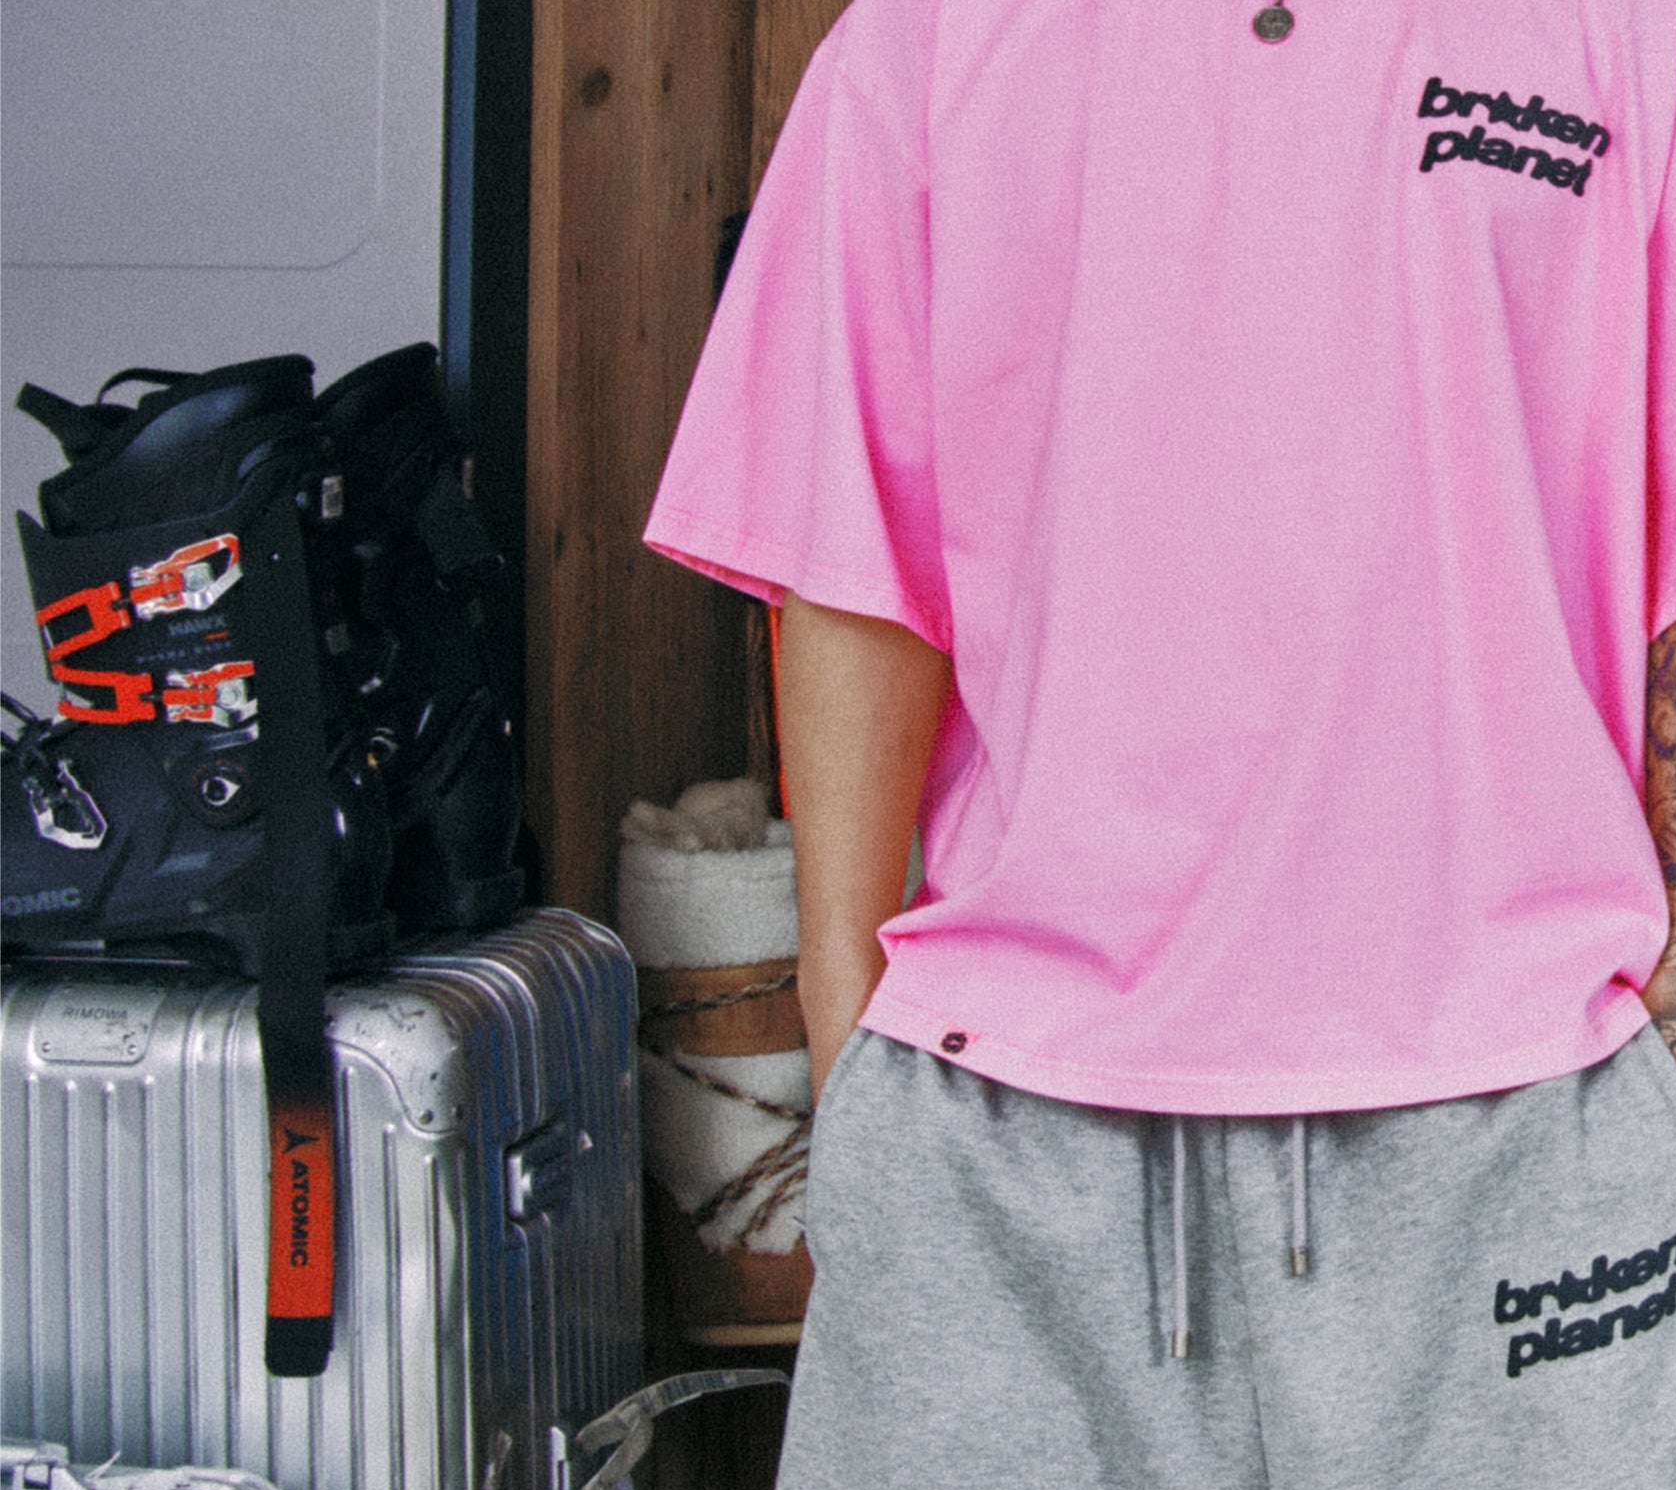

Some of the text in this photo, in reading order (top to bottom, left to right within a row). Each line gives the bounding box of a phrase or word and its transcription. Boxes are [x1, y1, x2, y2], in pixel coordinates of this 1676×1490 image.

[1419, 125, 1593, 197] planet
[62, 1006, 130, 1021] RIMOWA
[290, 1158, 310, 1268] ATOMIC
